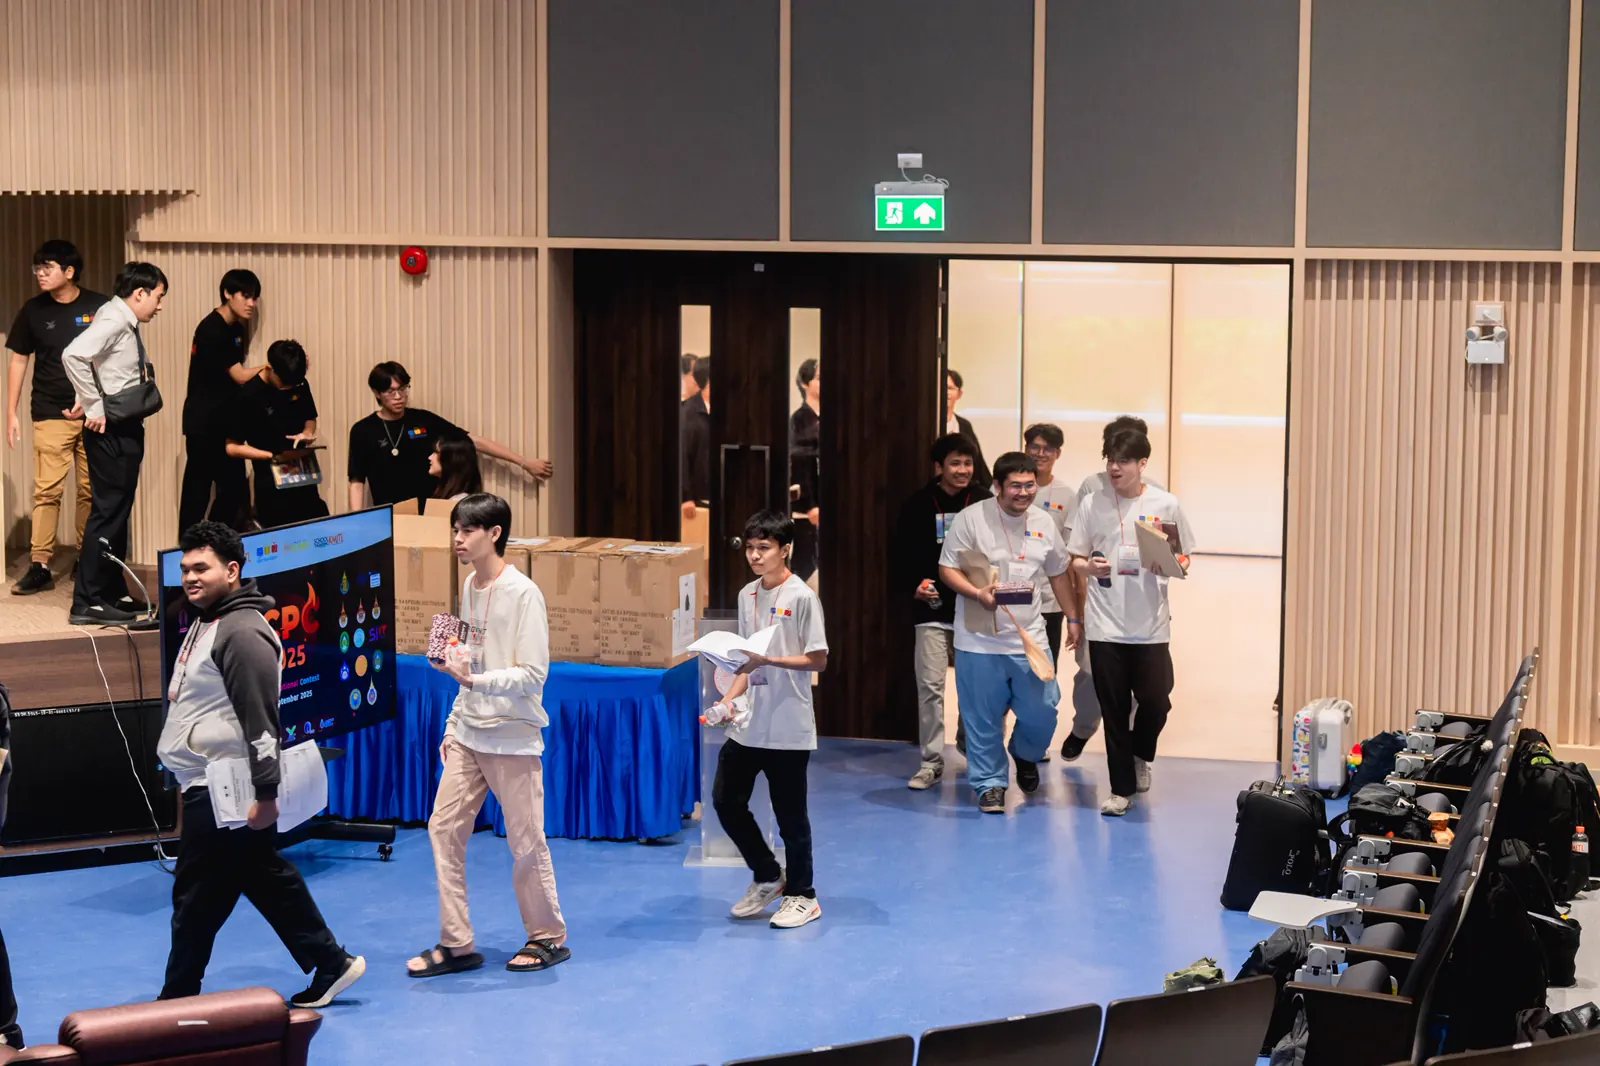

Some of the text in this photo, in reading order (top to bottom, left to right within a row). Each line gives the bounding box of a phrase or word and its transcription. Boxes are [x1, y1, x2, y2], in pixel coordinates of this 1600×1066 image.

[264, 582, 320, 640] CPC
[281, 644, 306, 670] 025
[280, 673, 320, 690] ational Contest
[278, 689, 313, 709] ptember 2025
